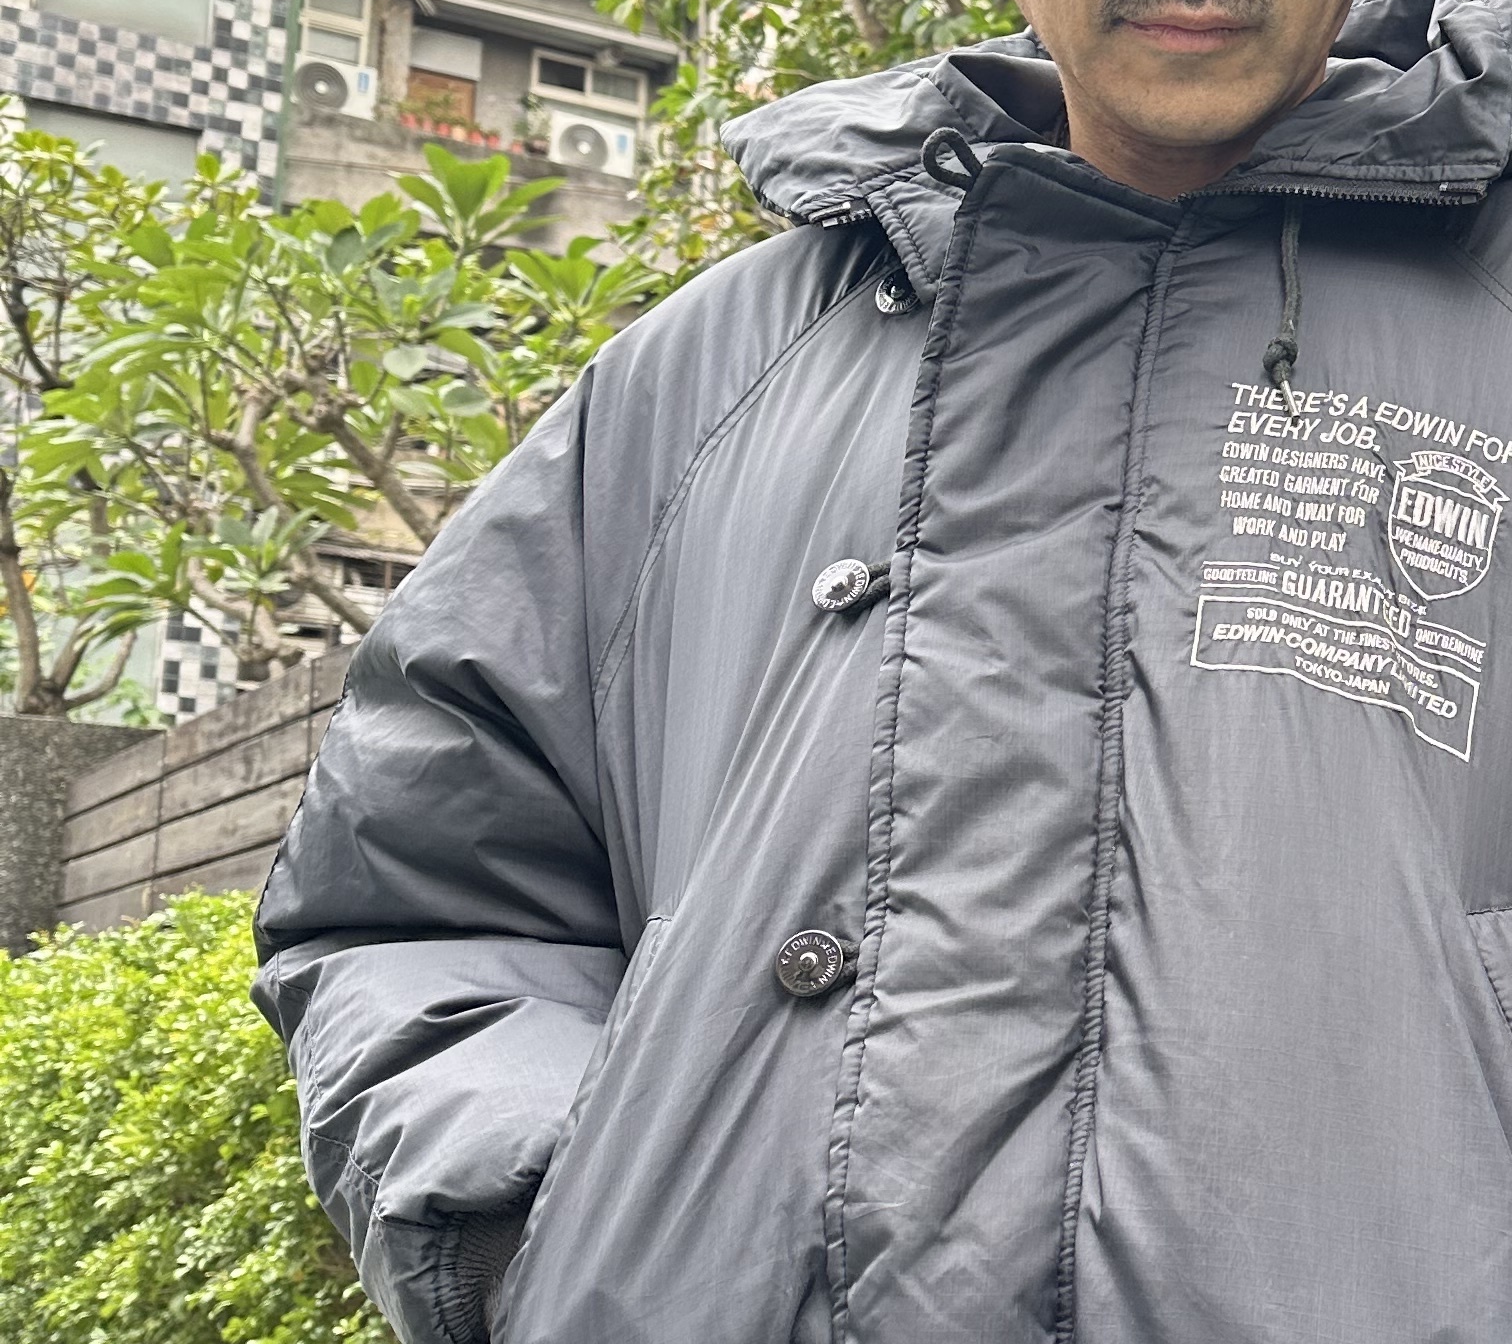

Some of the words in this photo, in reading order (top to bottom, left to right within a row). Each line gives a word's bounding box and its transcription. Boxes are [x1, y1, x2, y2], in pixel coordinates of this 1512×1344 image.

[1228, 411, 1321, 441] EVERY
[1320, 421, 1381, 452] JOB.
[1231, 382, 1349, 416] THERE'S
[1348, 396, 1368, 418] A
[1375, 401, 1466, 447] EDWIN
[1222, 441, 1270, 462] EDWIN
[1271, 447, 1350, 470] DESIGNERS
[1351, 457, 1387, 484] HAVE
[1284, 473, 1350, 497] GARMENT
[1351, 479, 1380, 505] FOR
[1220, 490, 1262, 510] HOME
[1263, 494, 1292, 517] AND
[1295, 502, 1336, 522] AWAY
[1337, 506, 1366, 528] FOR
[1397, 486, 1490, 549] EDWIN
[1232, 516, 1276, 538] WORK
[1278, 524, 1308, 548] AND
[1310, 531, 1347, 552] PLAY
[1270, 552, 1303, 567] BUY
[1308, 560, 1350, 576] YOUR
[1246, 607, 1278, 622] SOLD
[1281, 613, 1315, 631] ONLY
[1313, 622, 1330, 637] AT
[1333, 628, 1358, 645] THE
